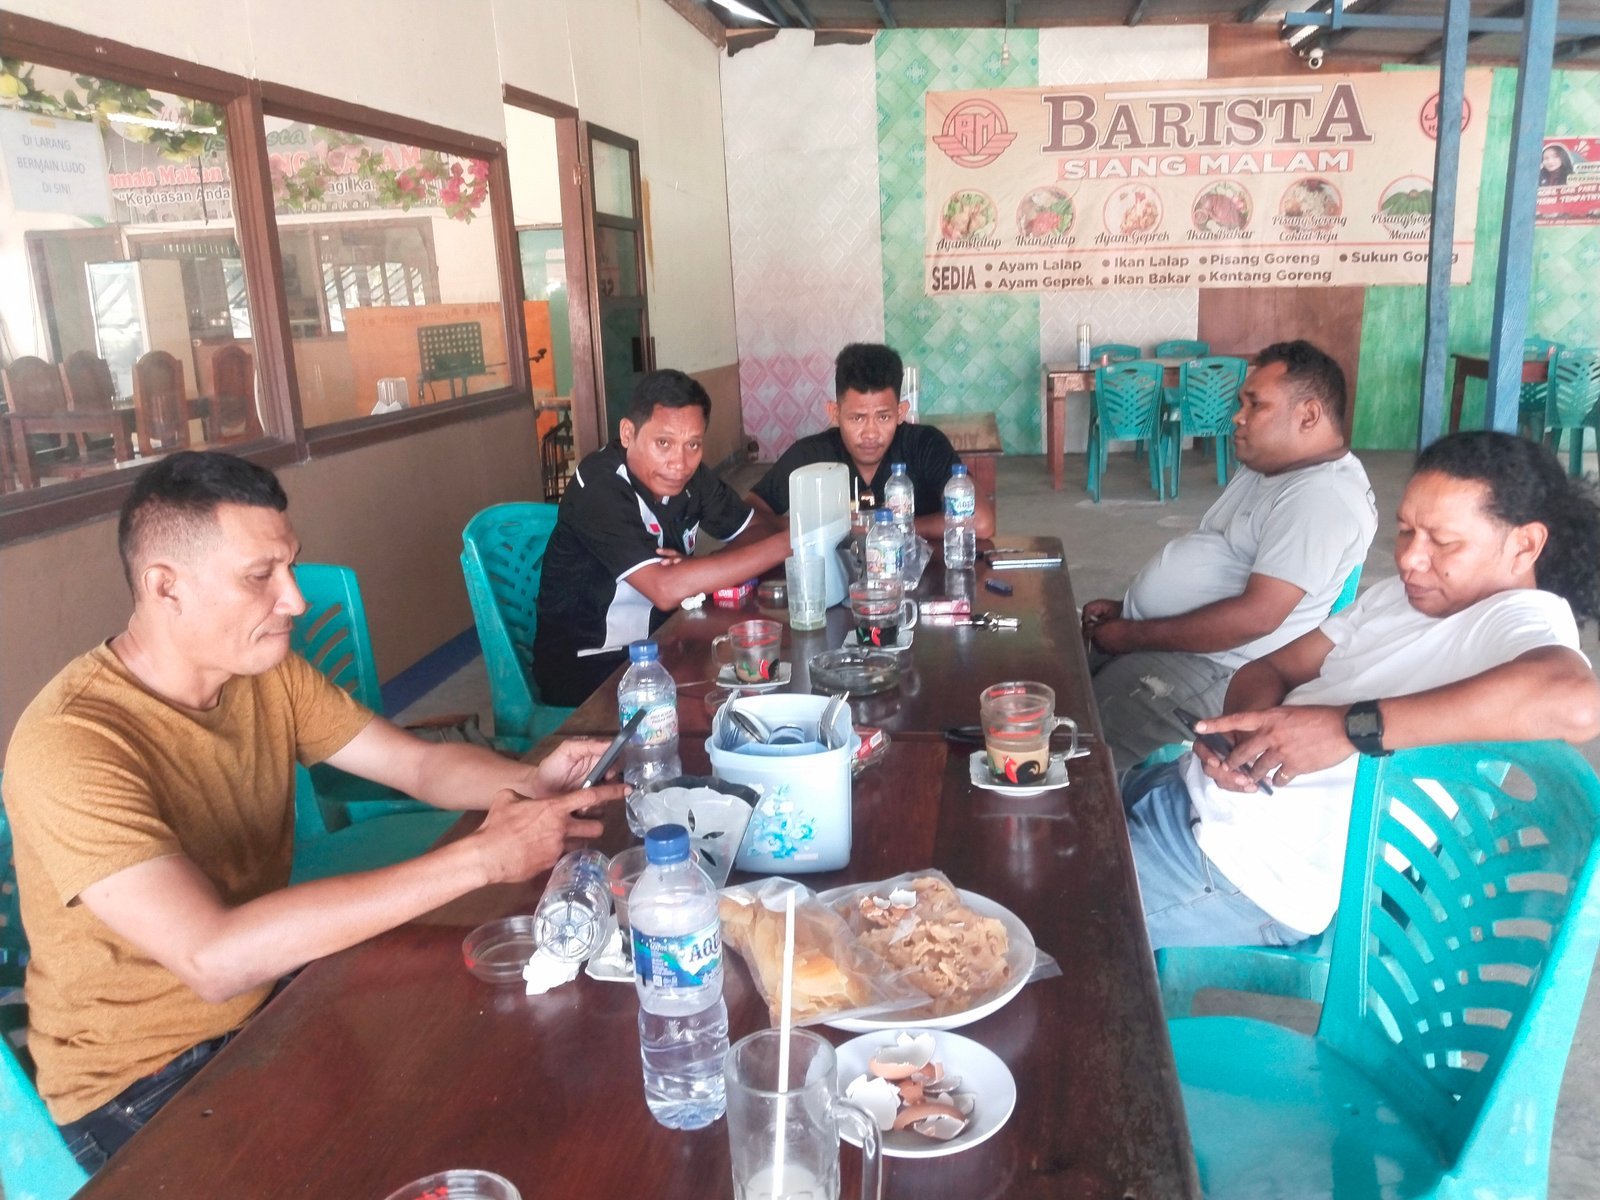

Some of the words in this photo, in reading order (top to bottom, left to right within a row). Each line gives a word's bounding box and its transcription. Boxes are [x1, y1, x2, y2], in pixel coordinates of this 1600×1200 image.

[1040, 83, 1373, 154] BARISTA
[35, 136, 72, 151] LARANG
[1064, 155, 1187, 180] SIANG
[1200, 150, 1349, 175] MALAM
[1094, 231, 1130, 247] Ayam
[1114, 256, 1145, 268] Ikan
[1149, 255, 1190, 269] Lalap
[1210, 253, 1260, 267] Pisang
[1264, 252, 1321, 266] Goreng
[1351, 251, 1399, 264] Sukun
[998, 260, 1039, 274] Ayam
[1043, 259, 1082, 272] Lalap
[931, 265, 977, 292] SEDIA
[998, 278, 1038, 290] Ayam
[1042, 275, 1094, 289] Geprek
[1113, 273, 1144, 286] Ikan
[1149, 272, 1192, 285] Bakar
[1209, 271, 1272, 284] Kentang
[1276, 269, 1333, 283] Goreng
